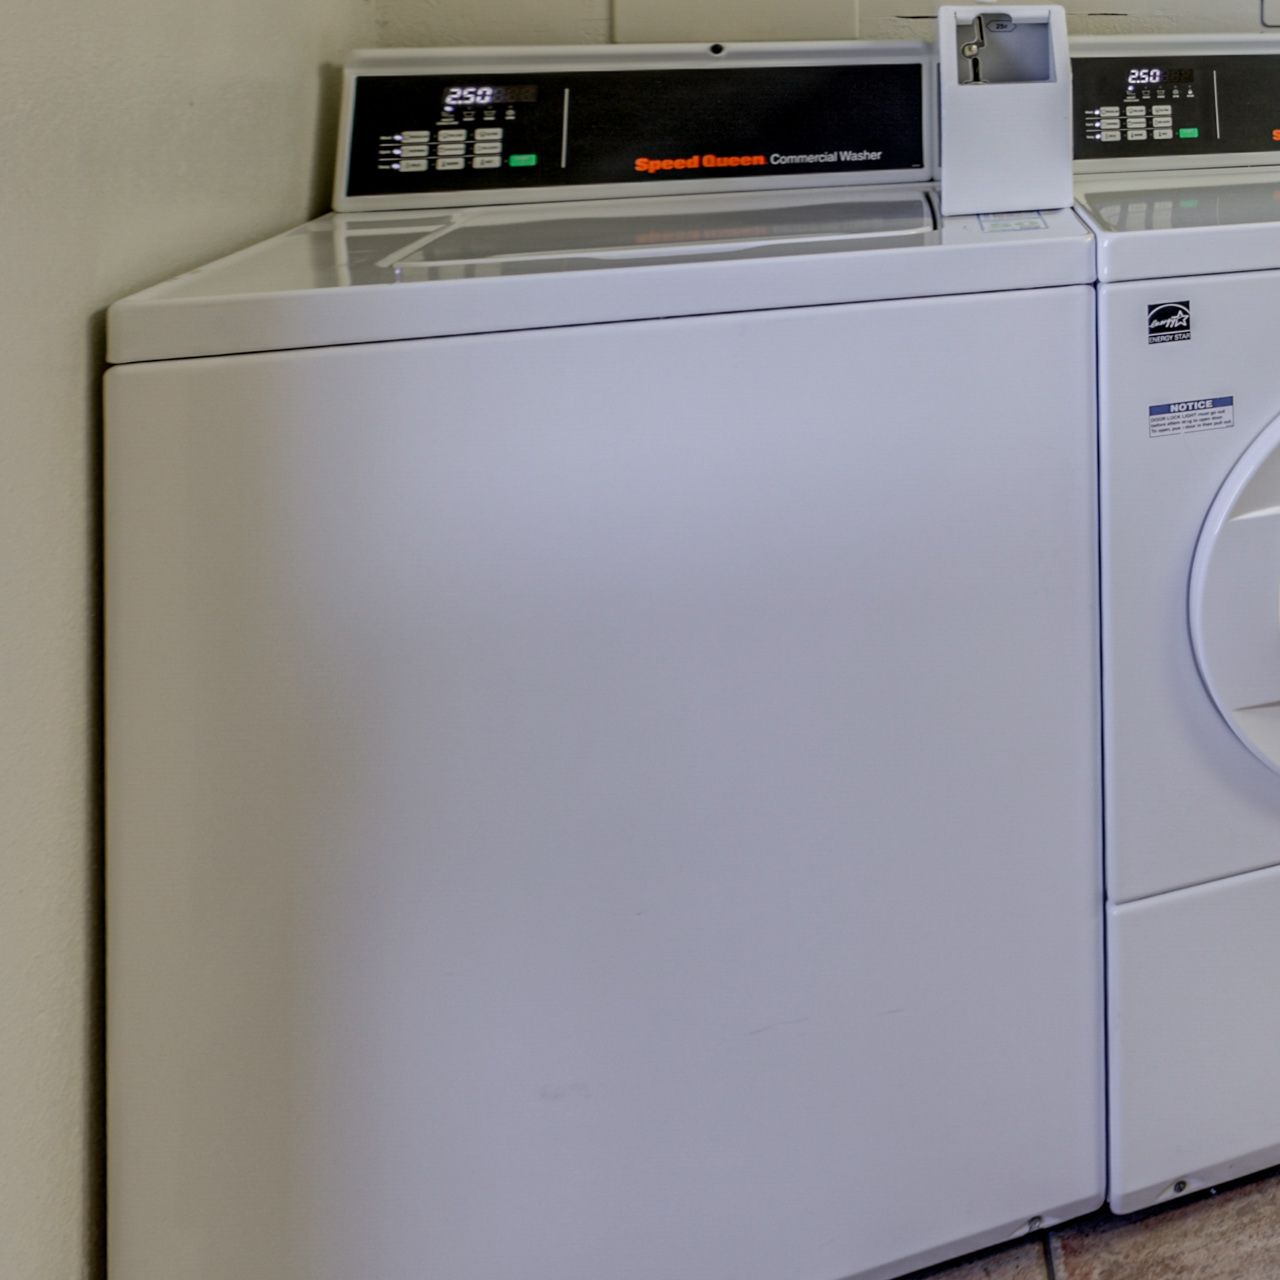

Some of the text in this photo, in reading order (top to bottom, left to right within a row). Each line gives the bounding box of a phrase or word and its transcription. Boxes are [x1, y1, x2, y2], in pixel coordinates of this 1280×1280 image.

[1128, 69, 1160, 84] 2.50
[444, 86, 494, 105] 2.50
[635, 150, 882, 174] Speed Queen Commercial Washer
[1149, 332, 1191, 344] ENERGY STAR
[1170, 400, 1213, 412] NOTICE
